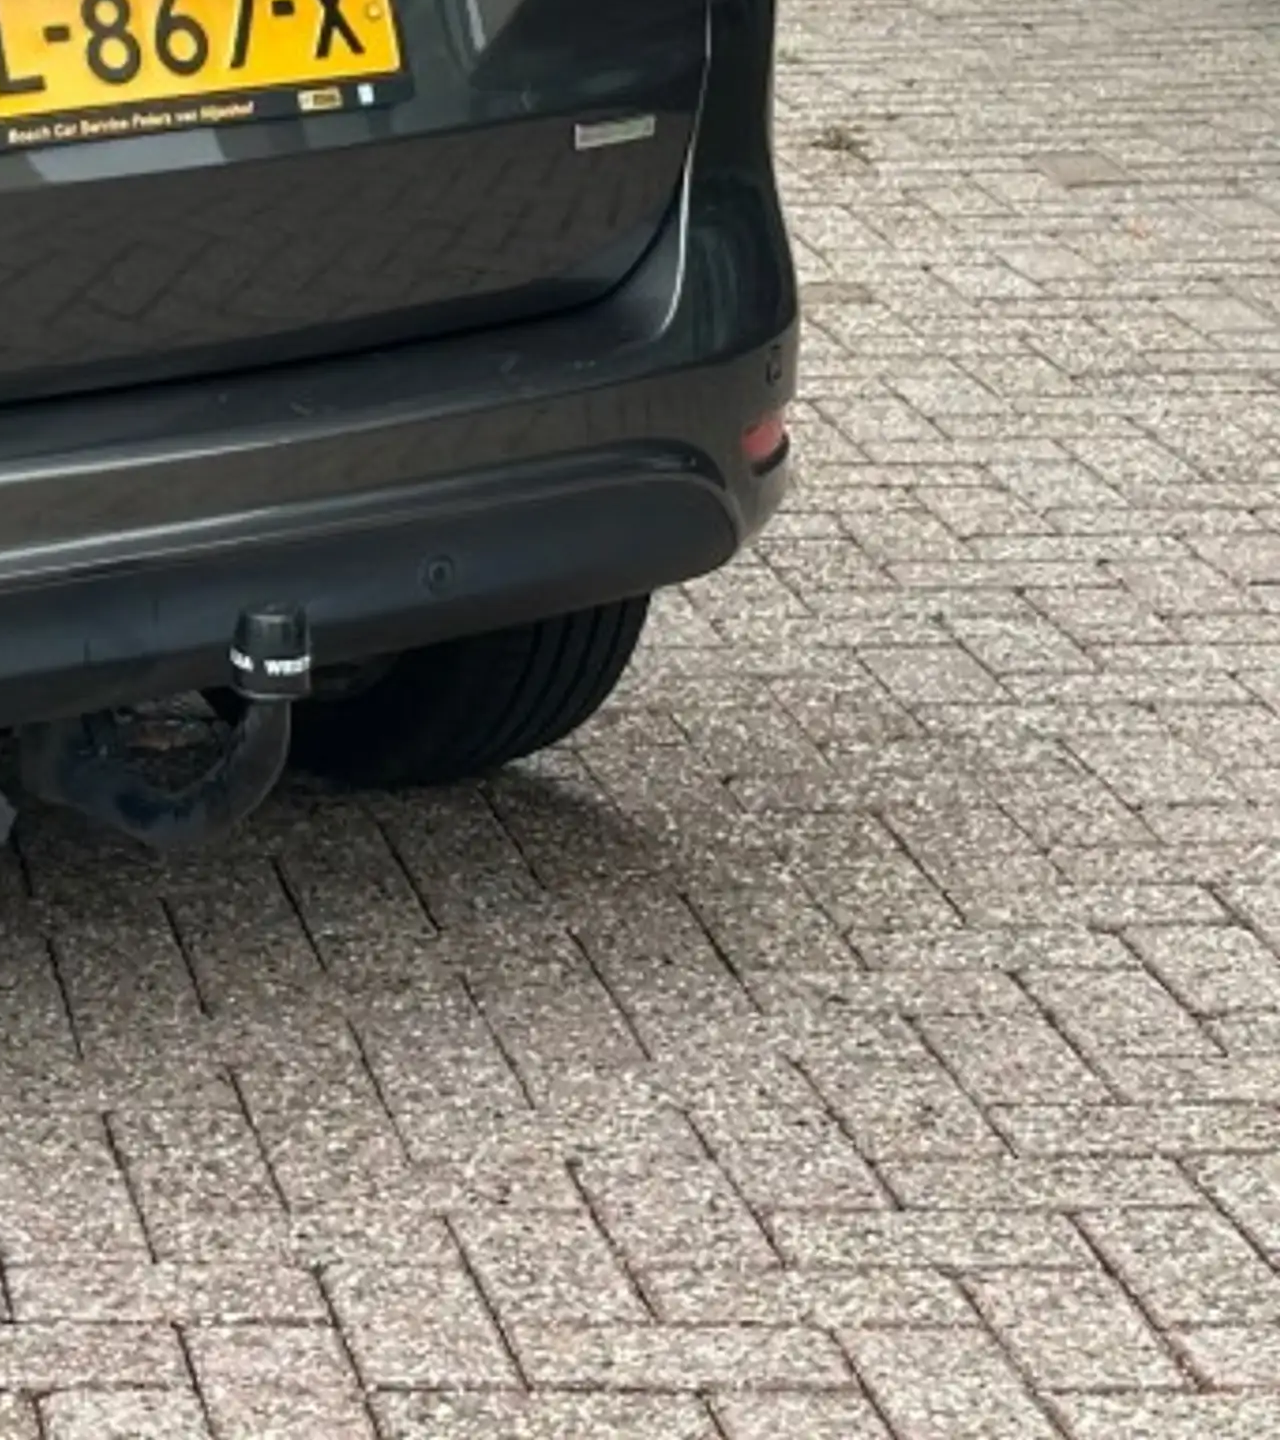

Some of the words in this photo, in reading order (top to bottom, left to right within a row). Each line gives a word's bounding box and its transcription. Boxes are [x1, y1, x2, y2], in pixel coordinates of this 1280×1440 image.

[53, 122, 77, 138] Car
[80, 117, 129, 136] Service
[174, 108, 197, 122] van
